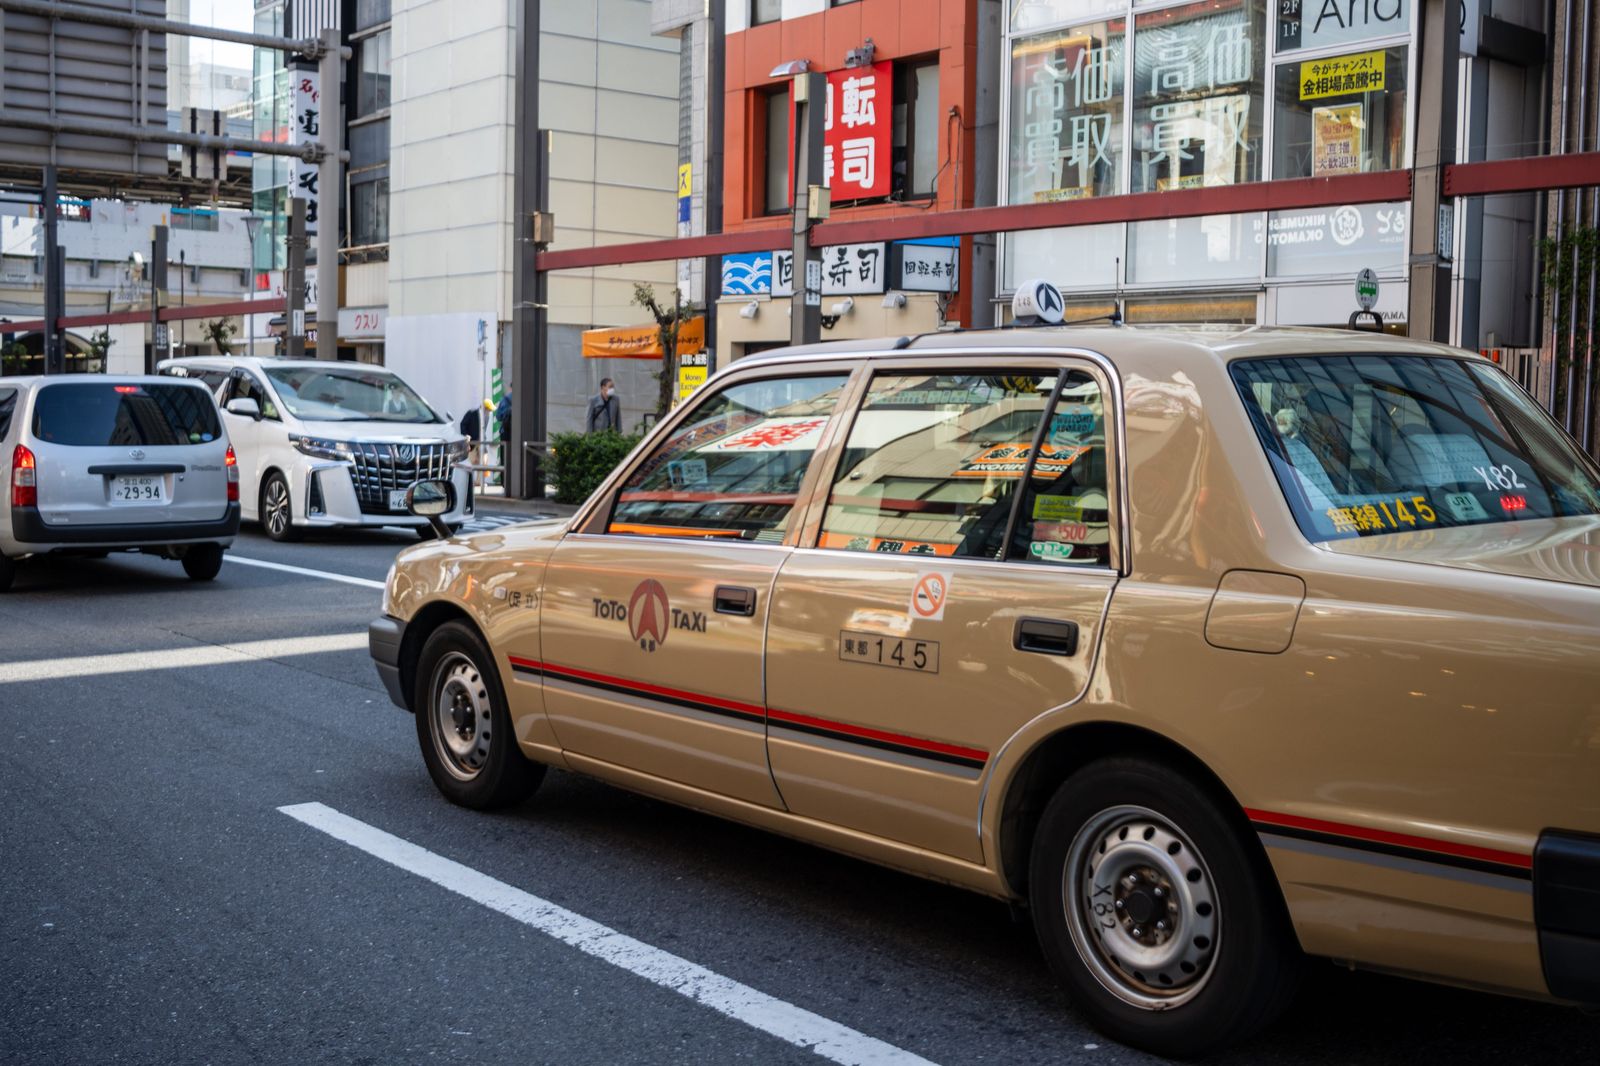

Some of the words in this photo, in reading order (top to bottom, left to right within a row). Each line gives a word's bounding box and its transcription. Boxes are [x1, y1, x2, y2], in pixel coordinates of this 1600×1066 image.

[1283, 21, 1299, 37] 1F
[1151, 21, 1252, 97] 高価
[1303, 69, 1383, 97] 金相場高騰中
[825, 75, 875, 131] 転
[778, 247, 879, 287] 回寿司
[905, 260, 956, 277] 回転寿司
[354, 313, 379, 331] クスリ
[1473, 464, 1527, 492] X82
[124, 487, 160, 499] 29-94
[875, 638, 927, 669] 145
